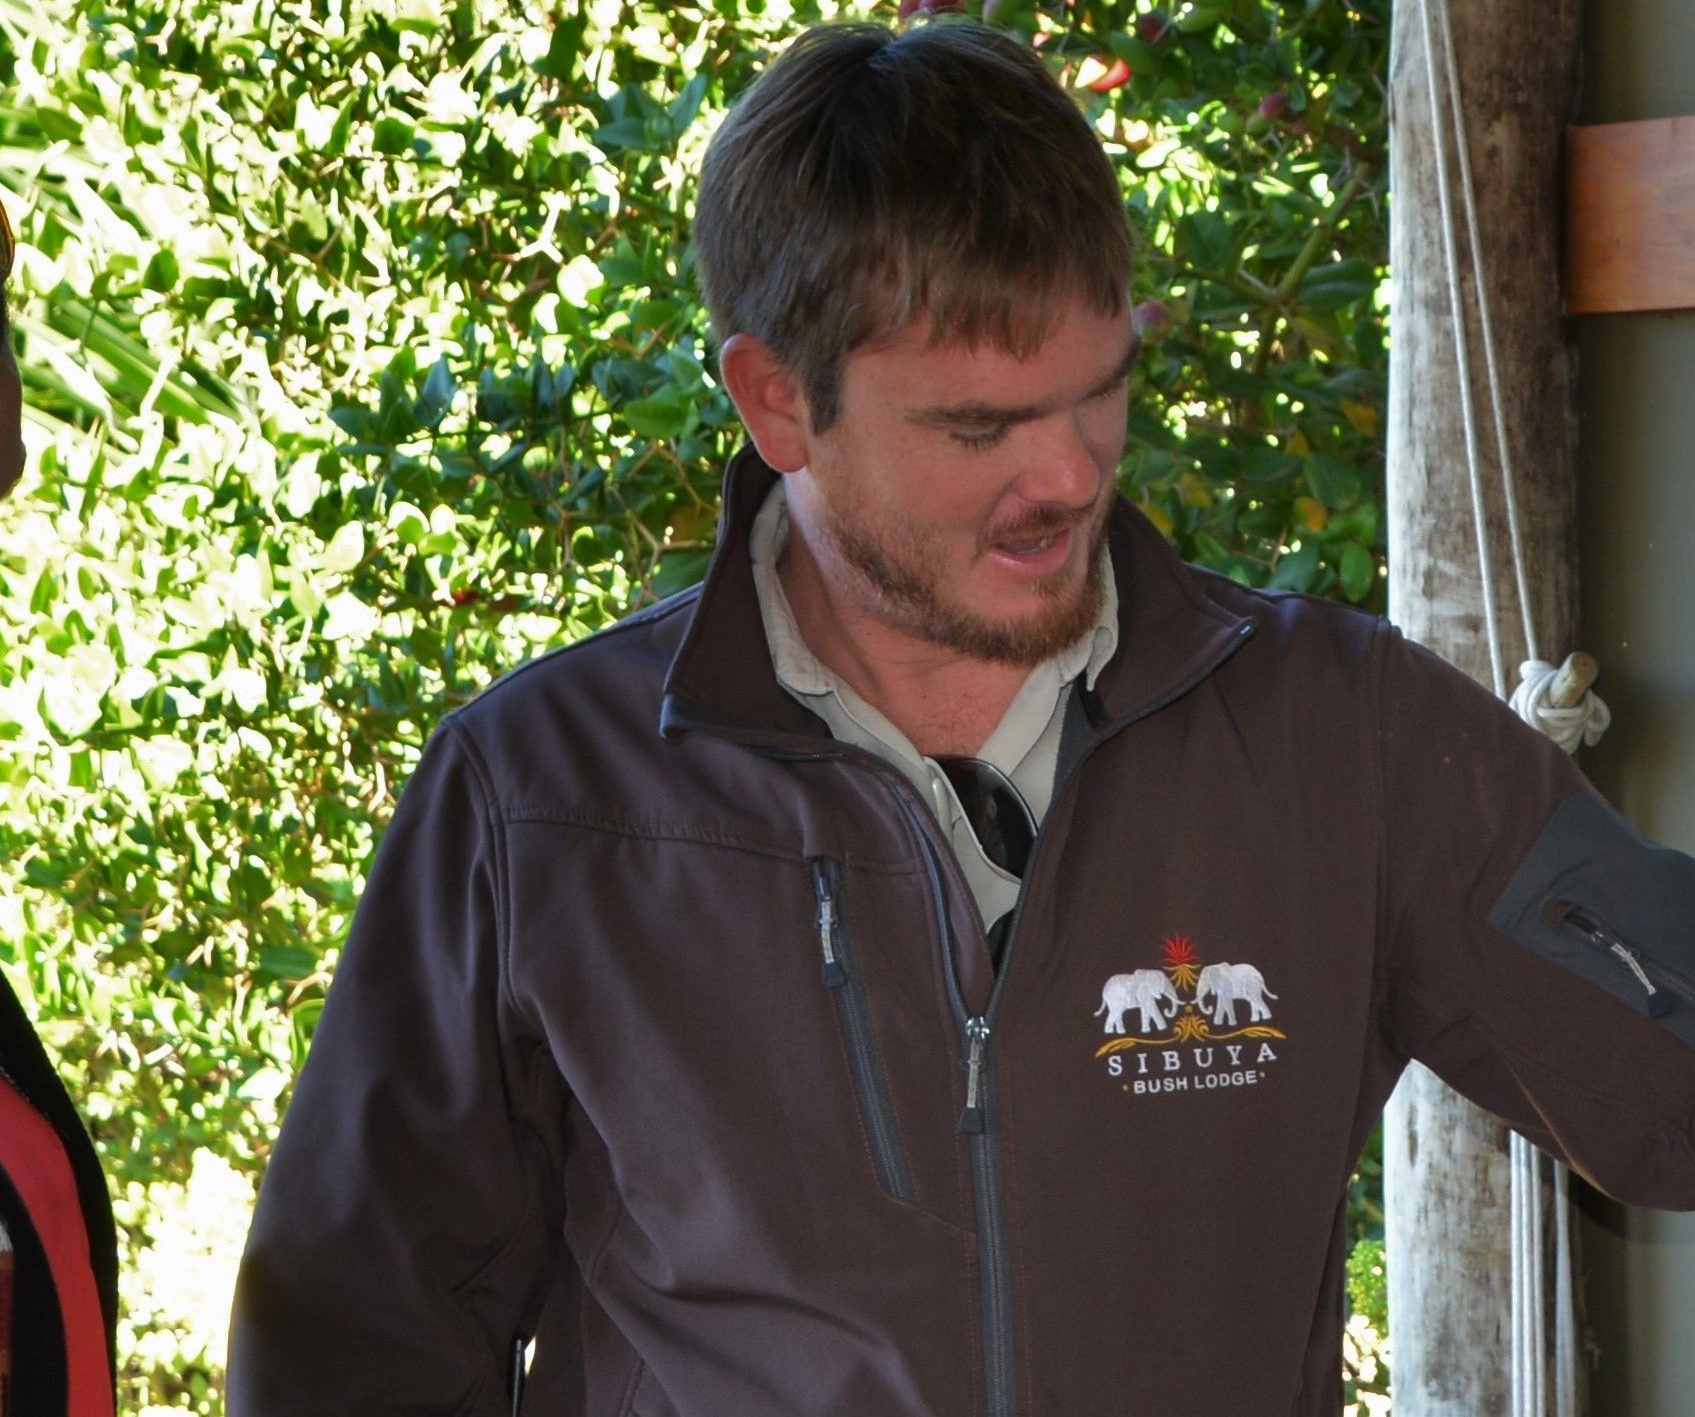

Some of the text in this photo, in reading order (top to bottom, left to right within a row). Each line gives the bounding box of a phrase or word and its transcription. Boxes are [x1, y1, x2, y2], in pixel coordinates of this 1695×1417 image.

[1107, 1042, 1277, 1076] SIBUYA
[1133, 1070, 1258, 1094] BUSH LODGE
